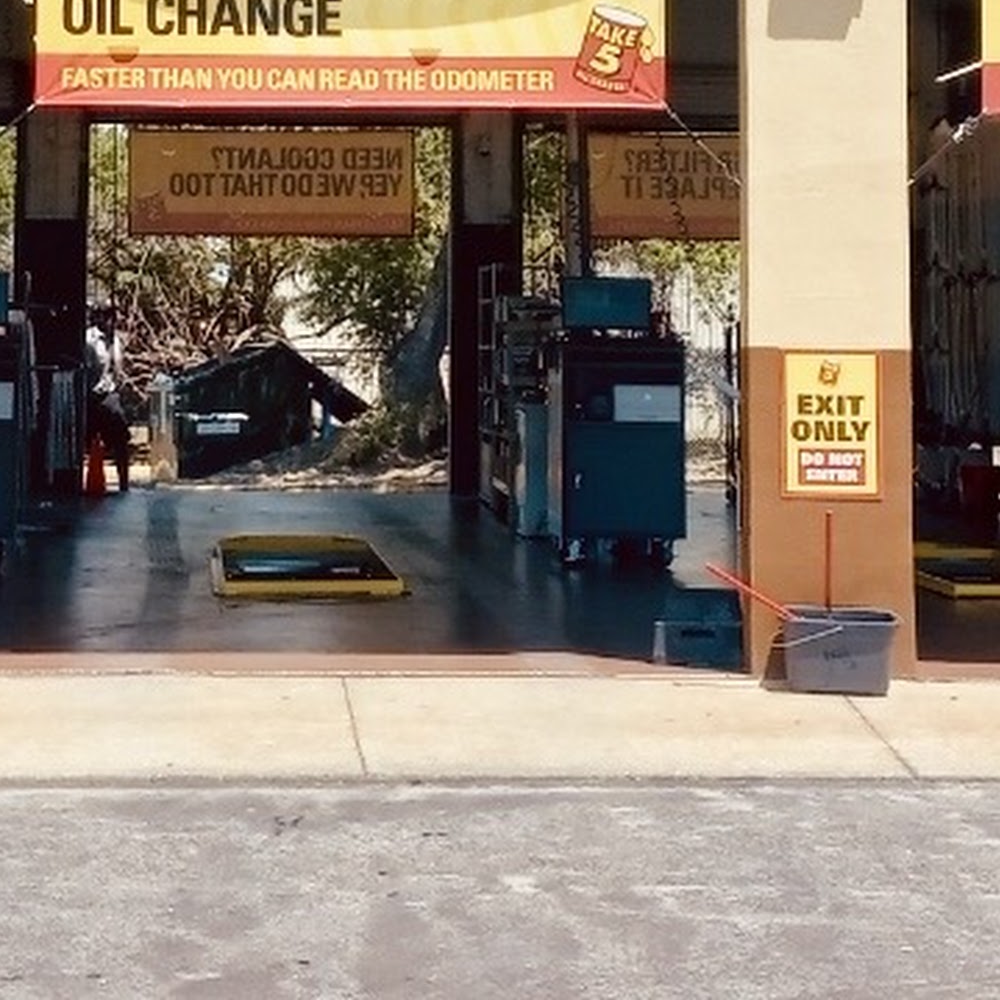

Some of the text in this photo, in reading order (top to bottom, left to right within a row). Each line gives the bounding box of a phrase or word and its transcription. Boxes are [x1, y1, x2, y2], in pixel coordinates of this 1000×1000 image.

[589, 16, 638, 48] TAKE
[588, 42, 622, 77] 5
[61, 68, 148, 91] FASTER
[148, 68, 213, 91] THAN
[216, 68, 263, 91] YOU
[267, 68, 314, 91] CAN
[319, 68, 379, 92] READ
[383, 68, 427, 92] THE
[430, 68, 555, 92] ODOMETER
[797, 394, 864, 416] EXIT
[791, 420, 870, 441] ONLY
[800, 452, 863, 466] DO NOT
